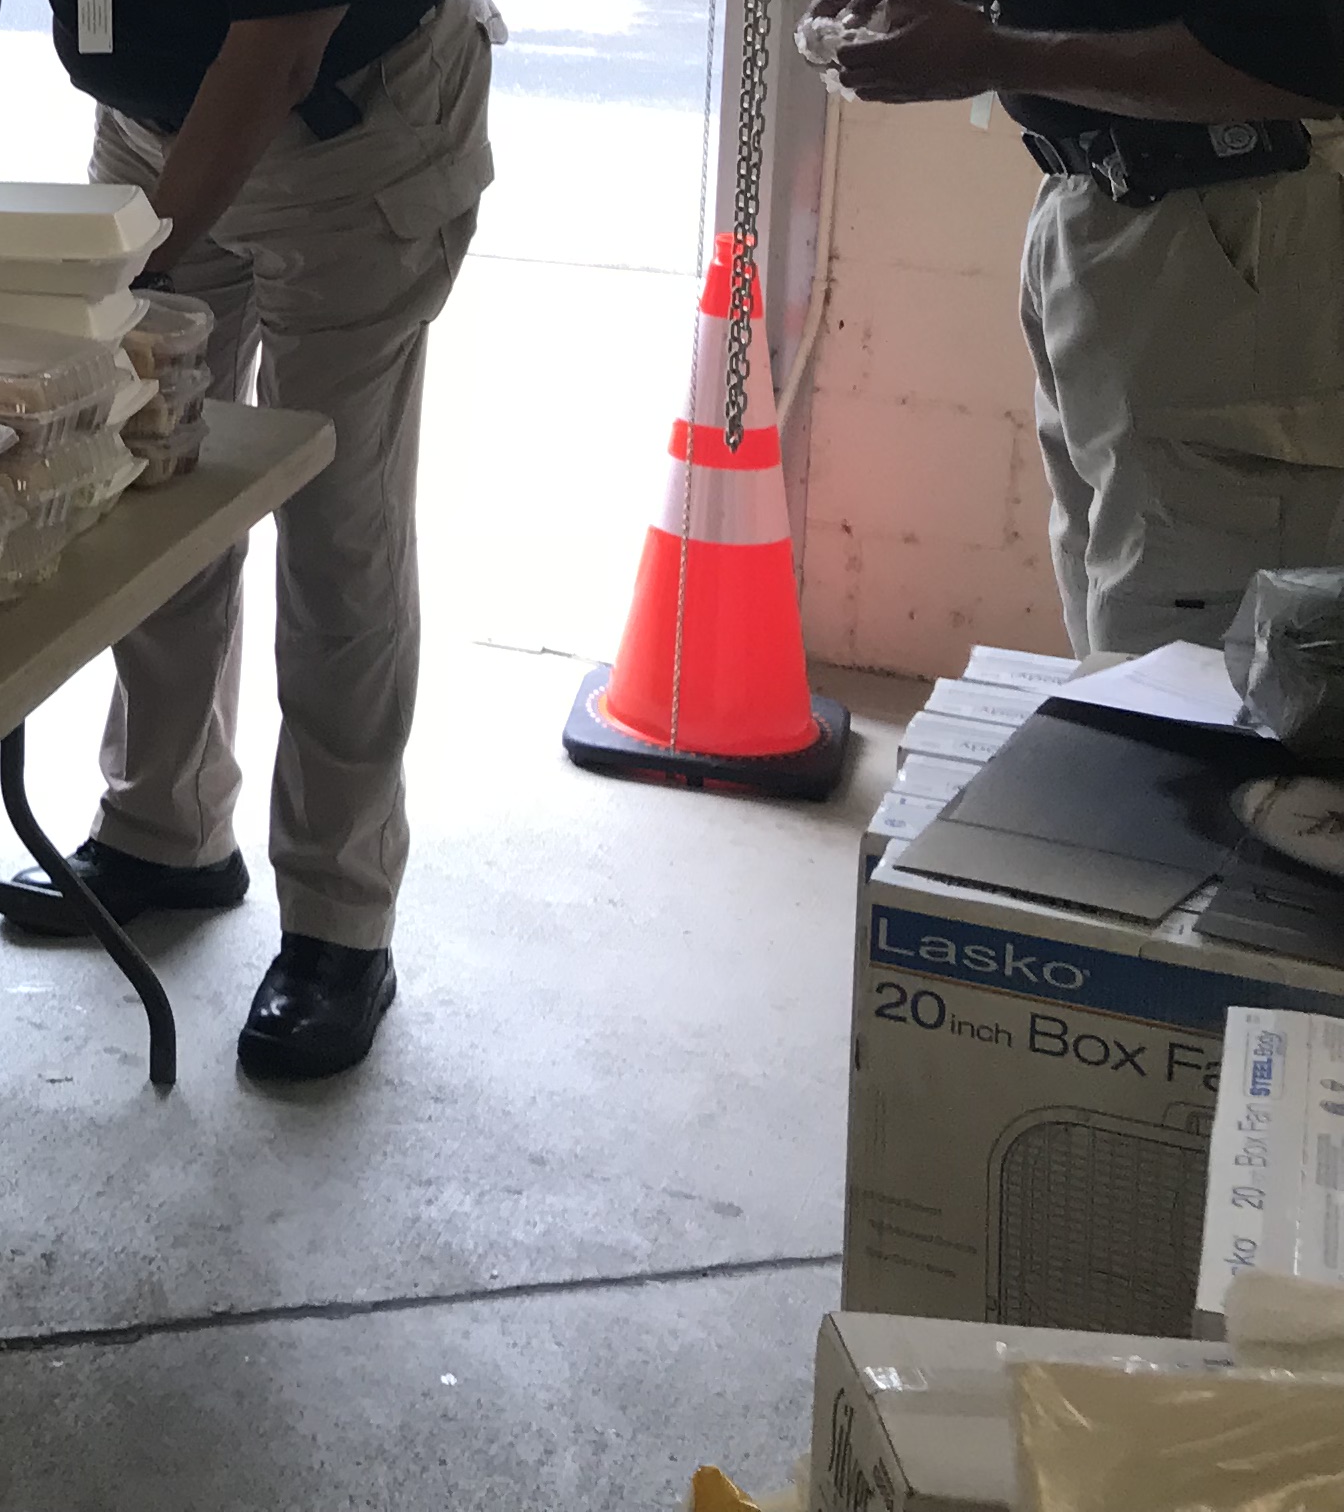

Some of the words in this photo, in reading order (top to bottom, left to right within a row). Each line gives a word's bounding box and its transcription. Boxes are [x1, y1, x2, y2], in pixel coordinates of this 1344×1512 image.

[878, 916, 1085, 989] Lasko
[1029, 1011, 1148, 1077] Box
[1167, 1041, 1223, 1093] Fa
[1237, 1101, 1272, 1133] Fan
[1234, 1136, 1268, 1168] Box
[1231, 1186, 1266, 1211] 20
